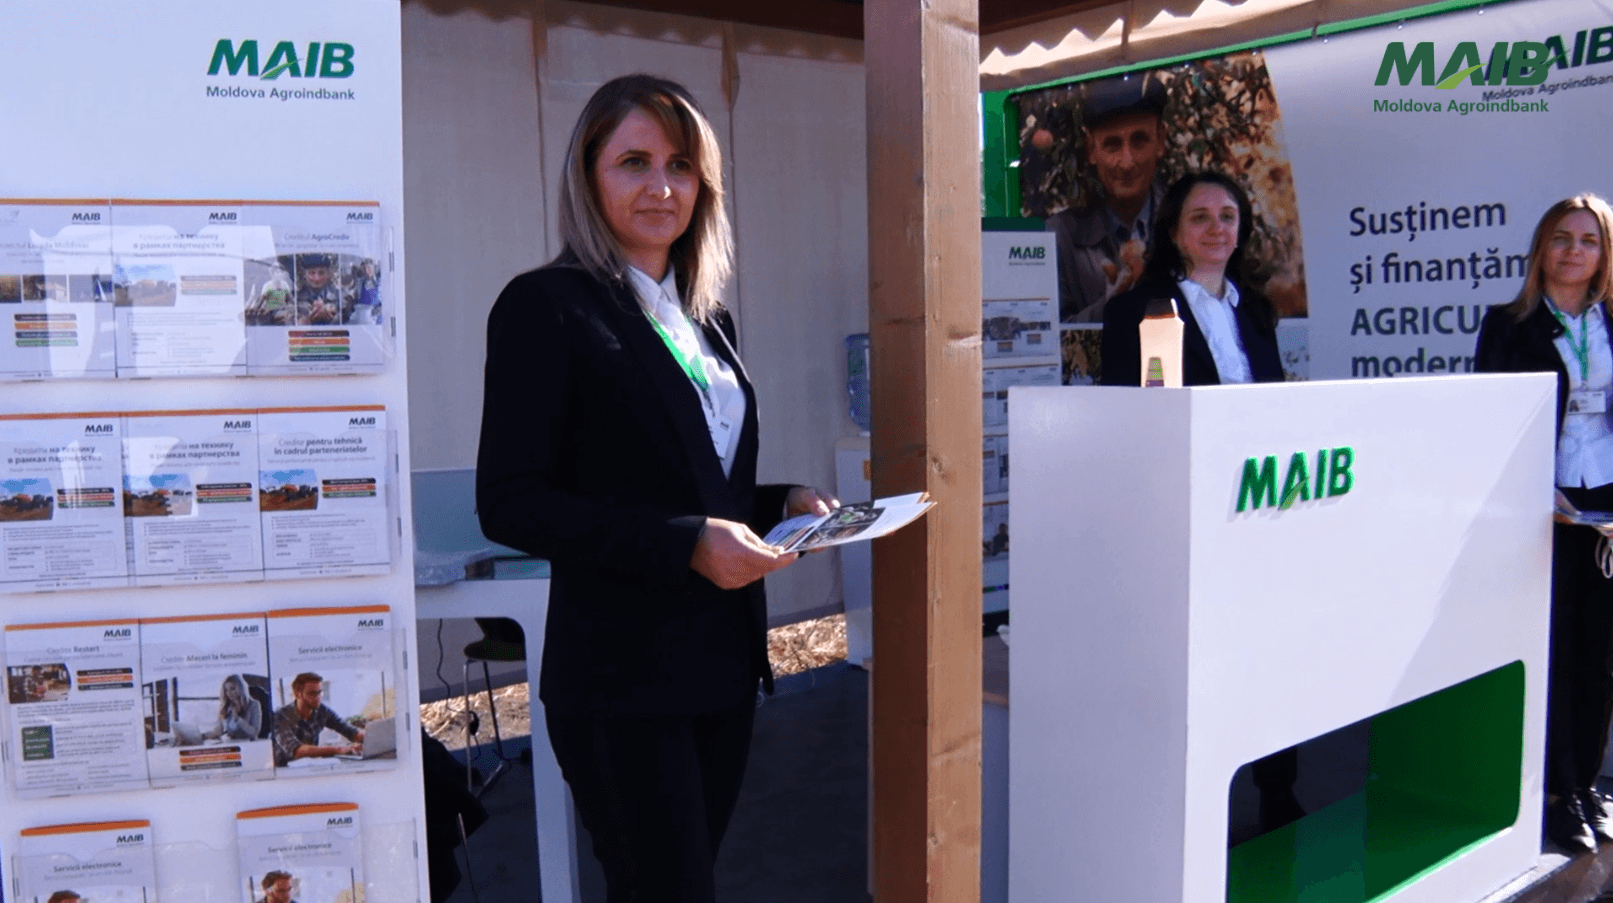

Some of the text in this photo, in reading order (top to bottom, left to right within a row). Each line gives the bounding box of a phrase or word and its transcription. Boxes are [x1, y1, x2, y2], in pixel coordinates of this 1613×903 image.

[207, 38, 355, 80] MAIB
[206, 86, 355, 101] Moldova Agroindbank
[1482, 86, 1534, 102] Moldova
[71, 212, 101, 221] MAIB
[208, 212, 237, 221] MAIB
[346, 212, 373, 220] MAIB
[1349, 201, 1506, 242] Susținem
[1009, 246, 1046, 260] MAIB
[1350, 255, 1372, 294] și
[223, 420, 251, 429] MAIB
[348, 417, 376, 426] MAIB
[85, 424, 114, 433] MAIB
[306, 438, 332, 448] pentru
[283, 447, 308, 455] cadrul
[1235, 445, 1357, 514] MAIB
[357, 619, 384, 627] MAIB
[104, 628, 131, 638] MAIB
[232, 625, 259, 634] MAIB
[73, 645, 100, 653] Restart
[327, 816, 353, 826] MAIB
[116, 833, 144, 843] MAIB
